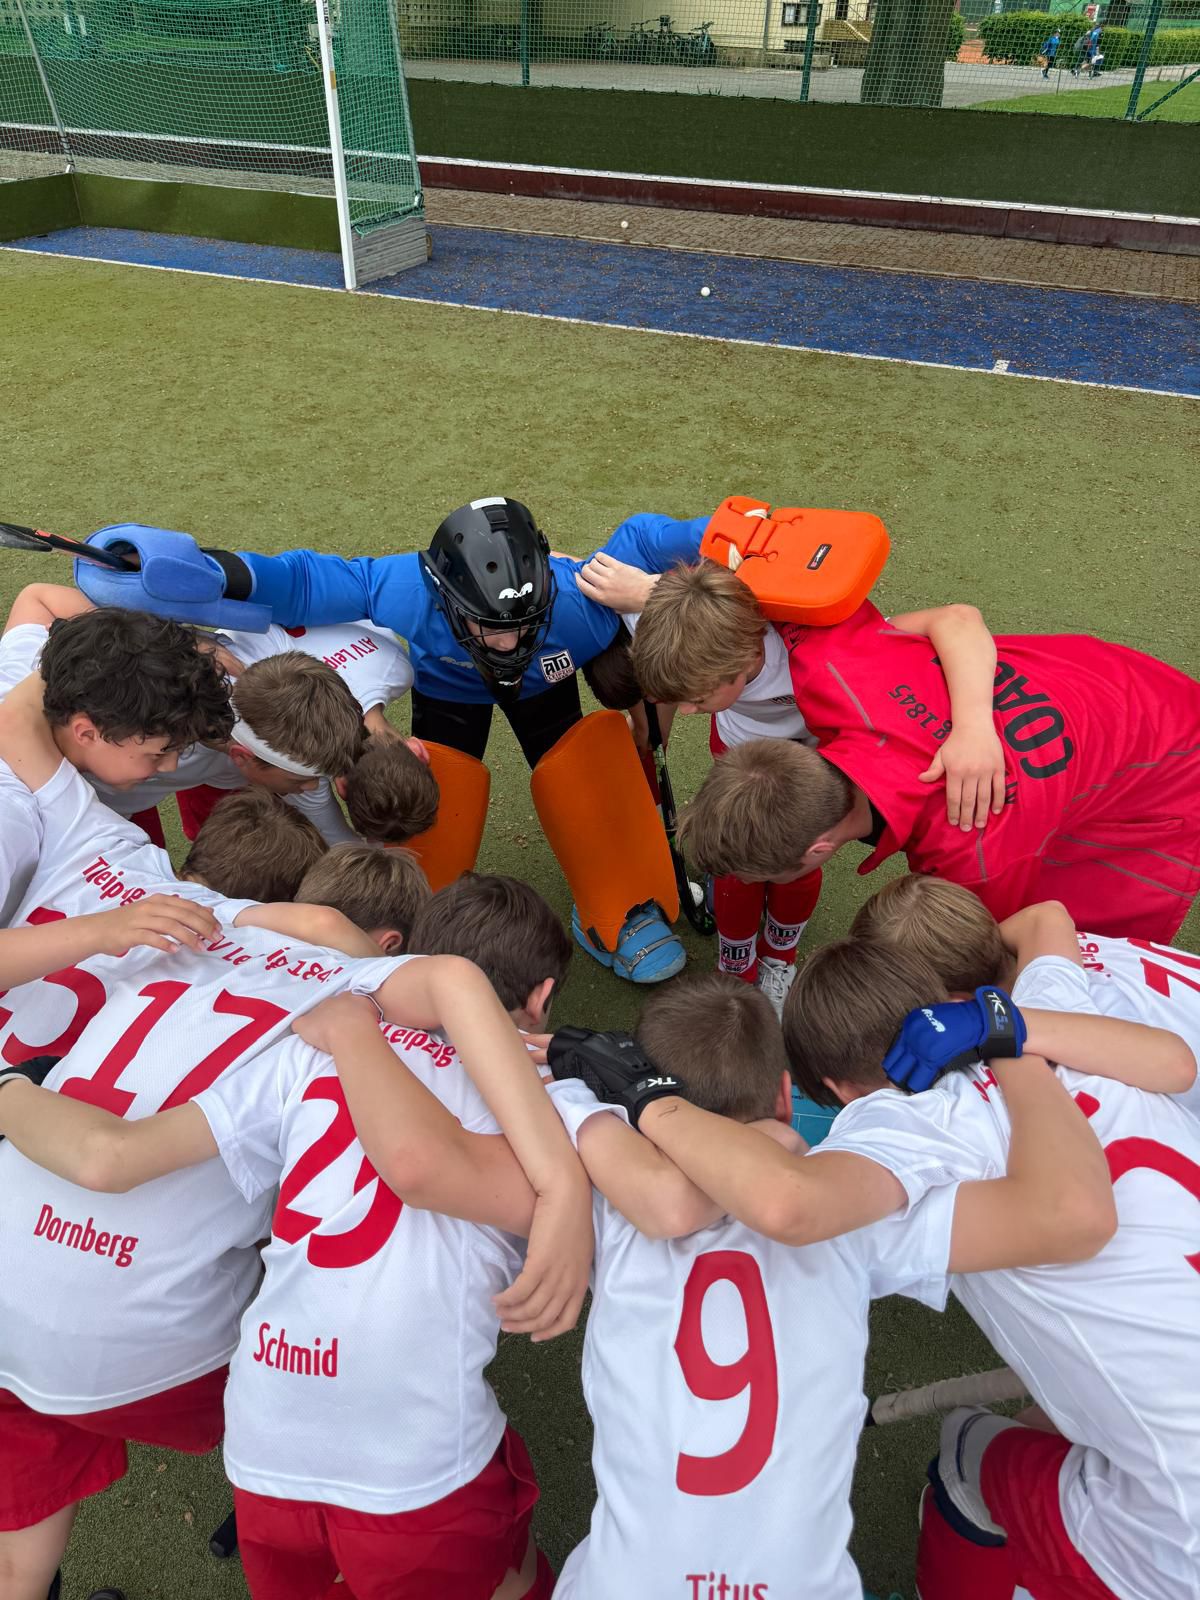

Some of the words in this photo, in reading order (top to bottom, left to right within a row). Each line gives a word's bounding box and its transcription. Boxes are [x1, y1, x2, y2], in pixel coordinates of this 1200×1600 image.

[322, 648, 358, 671] Leip
[350, 636, 379, 658] ATV
[888, 684, 938, 729] 1845
[60, 980, 290, 1117] 17
[33, 1203, 139, 1268] Dornberg
[253, 1322, 338, 1378] Schmid
[674, 1250, 778, 1496] 9
[686, 1571, 769, 1600] Titus
